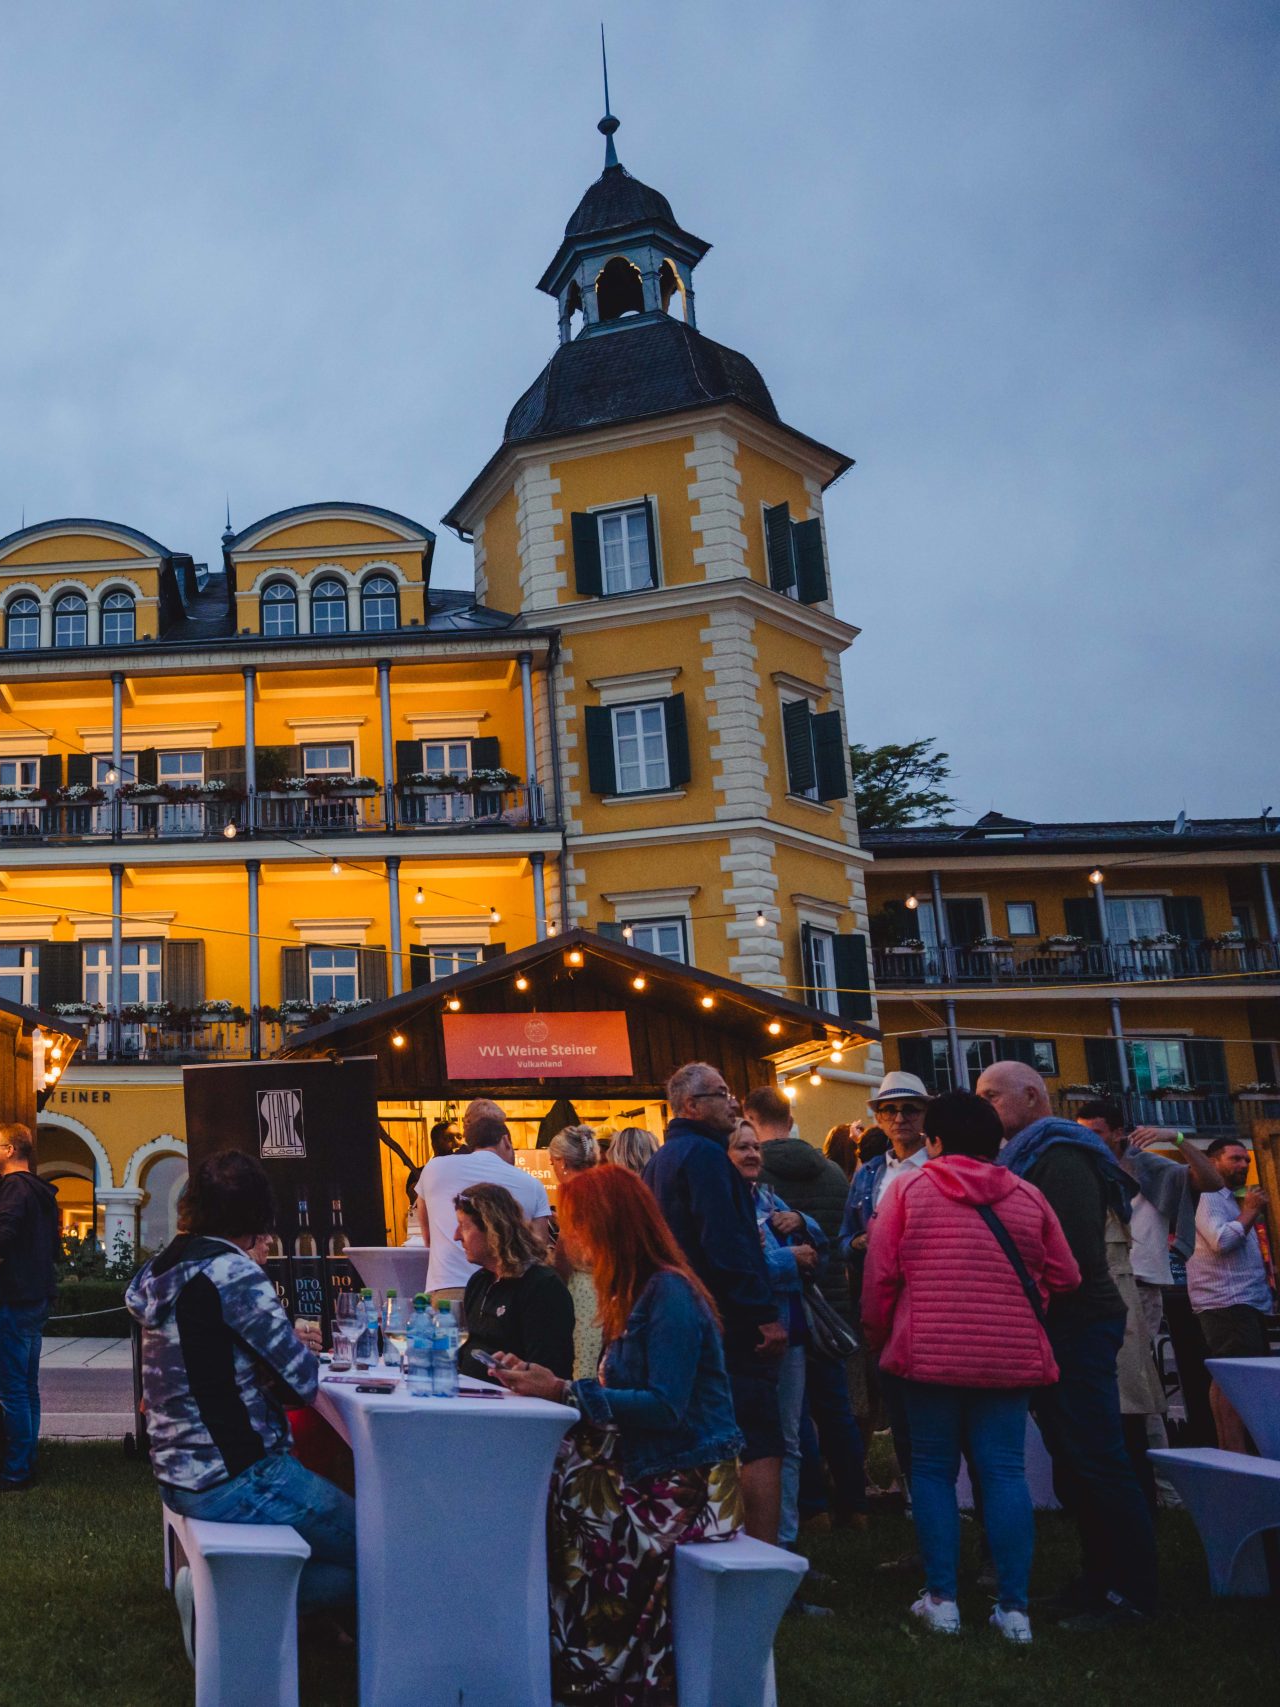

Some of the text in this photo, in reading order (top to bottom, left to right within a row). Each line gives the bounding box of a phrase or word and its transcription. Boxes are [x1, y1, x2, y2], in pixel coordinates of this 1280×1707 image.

[478, 1044, 598, 1057] VVL Weine Steiner
[517, 1060, 563, 1068] Vulkanland
